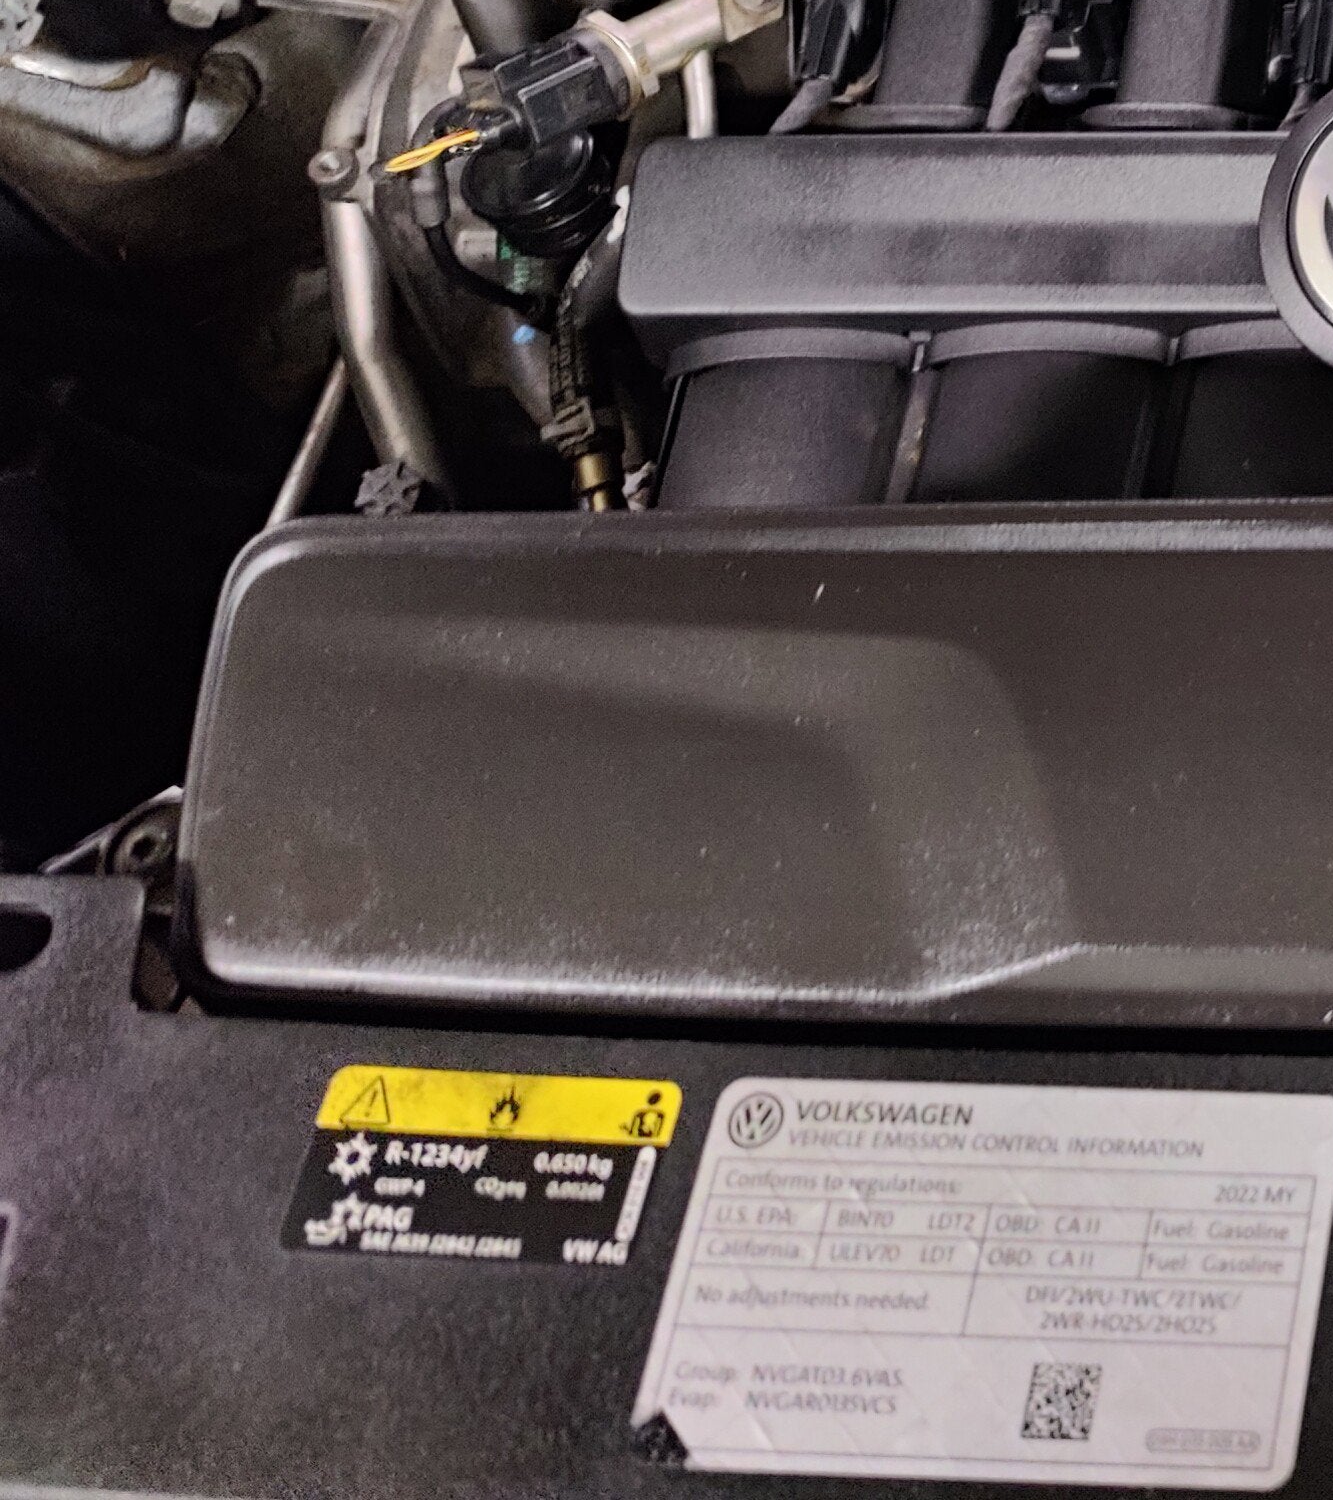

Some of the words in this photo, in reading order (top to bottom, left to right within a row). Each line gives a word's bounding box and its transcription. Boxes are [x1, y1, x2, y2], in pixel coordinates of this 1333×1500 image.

[793, 1099, 974, 1126] VOLKSWAGEN
[382, 1138, 488, 1174] R-1234yf
[787, 1127, 867, 1148] VEHICLE
[871, 1130, 966, 1151] EMISSION
[970, 1133, 1060, 1154] CONTROL
[1067, 1136, 1204, 1158] INFORMATION
[1214, 1183, 1259, 1203] 2022
